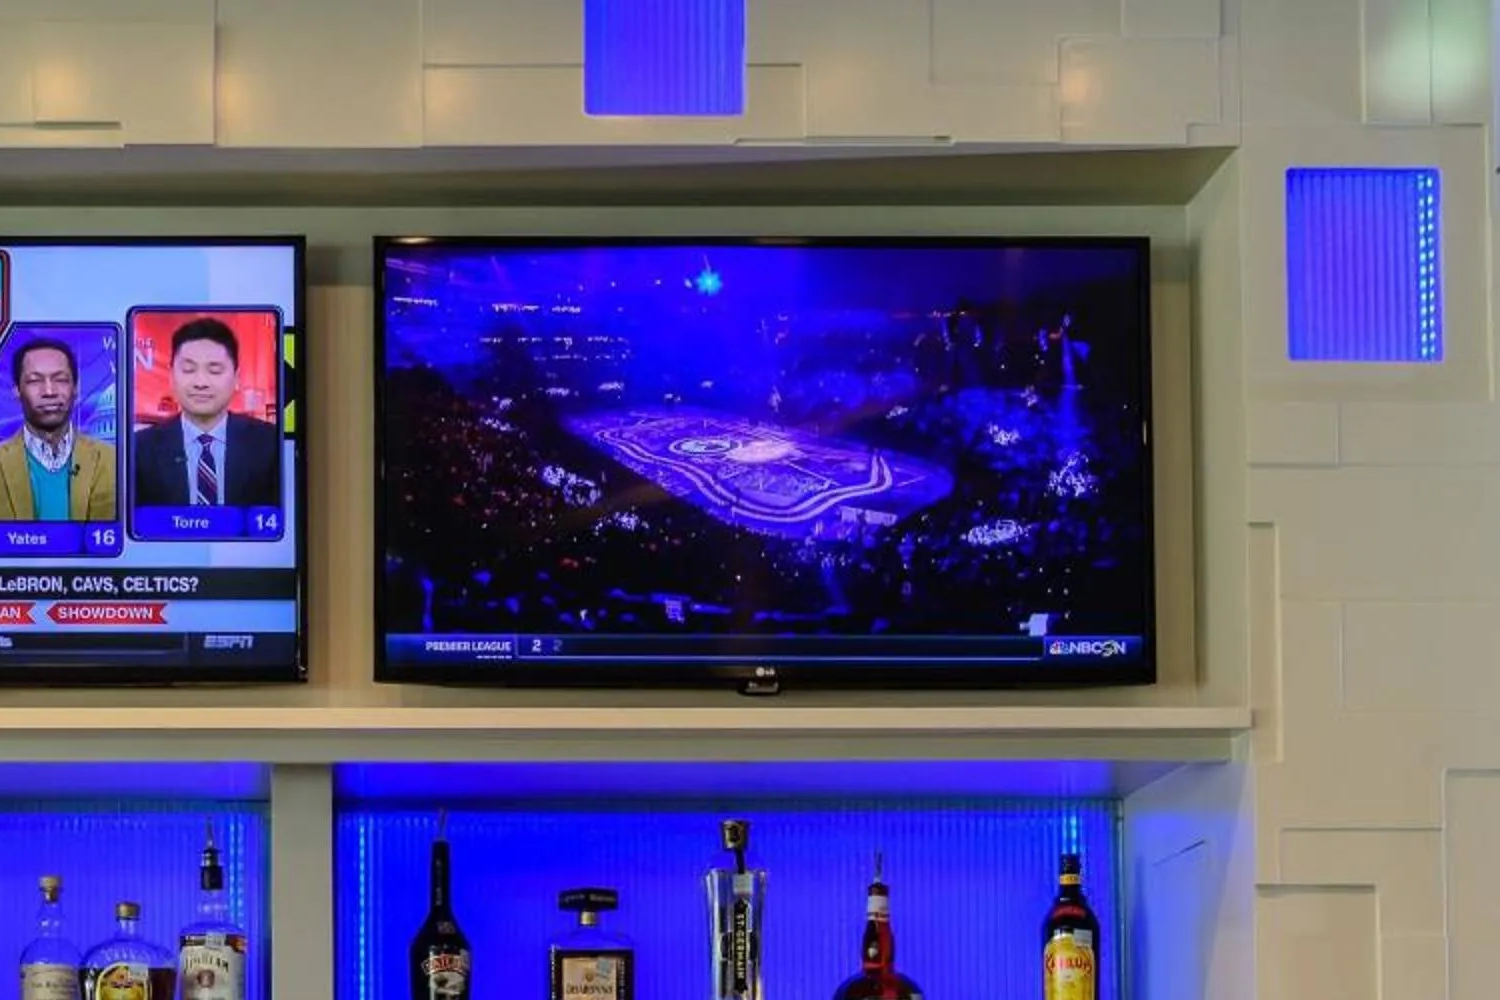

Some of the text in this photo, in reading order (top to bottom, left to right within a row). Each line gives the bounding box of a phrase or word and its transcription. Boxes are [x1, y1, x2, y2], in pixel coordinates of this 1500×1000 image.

[172, 516, 209, 529] Torre
[255, 515, 277, 529] 14
[7, 533, 47, 546] Yates
[92, 531, 115, 546] 16
[72, 577, 119, 594] CAVS,
[123, 577, 199, 592] CELTICS?
[57, 607, 153, 619] SHOWDOWN
[204, 635, 253, 648] ESPN
[426, 641, 470, 651] PREMIER
[472, 641, 511, 651] LEAGUE
